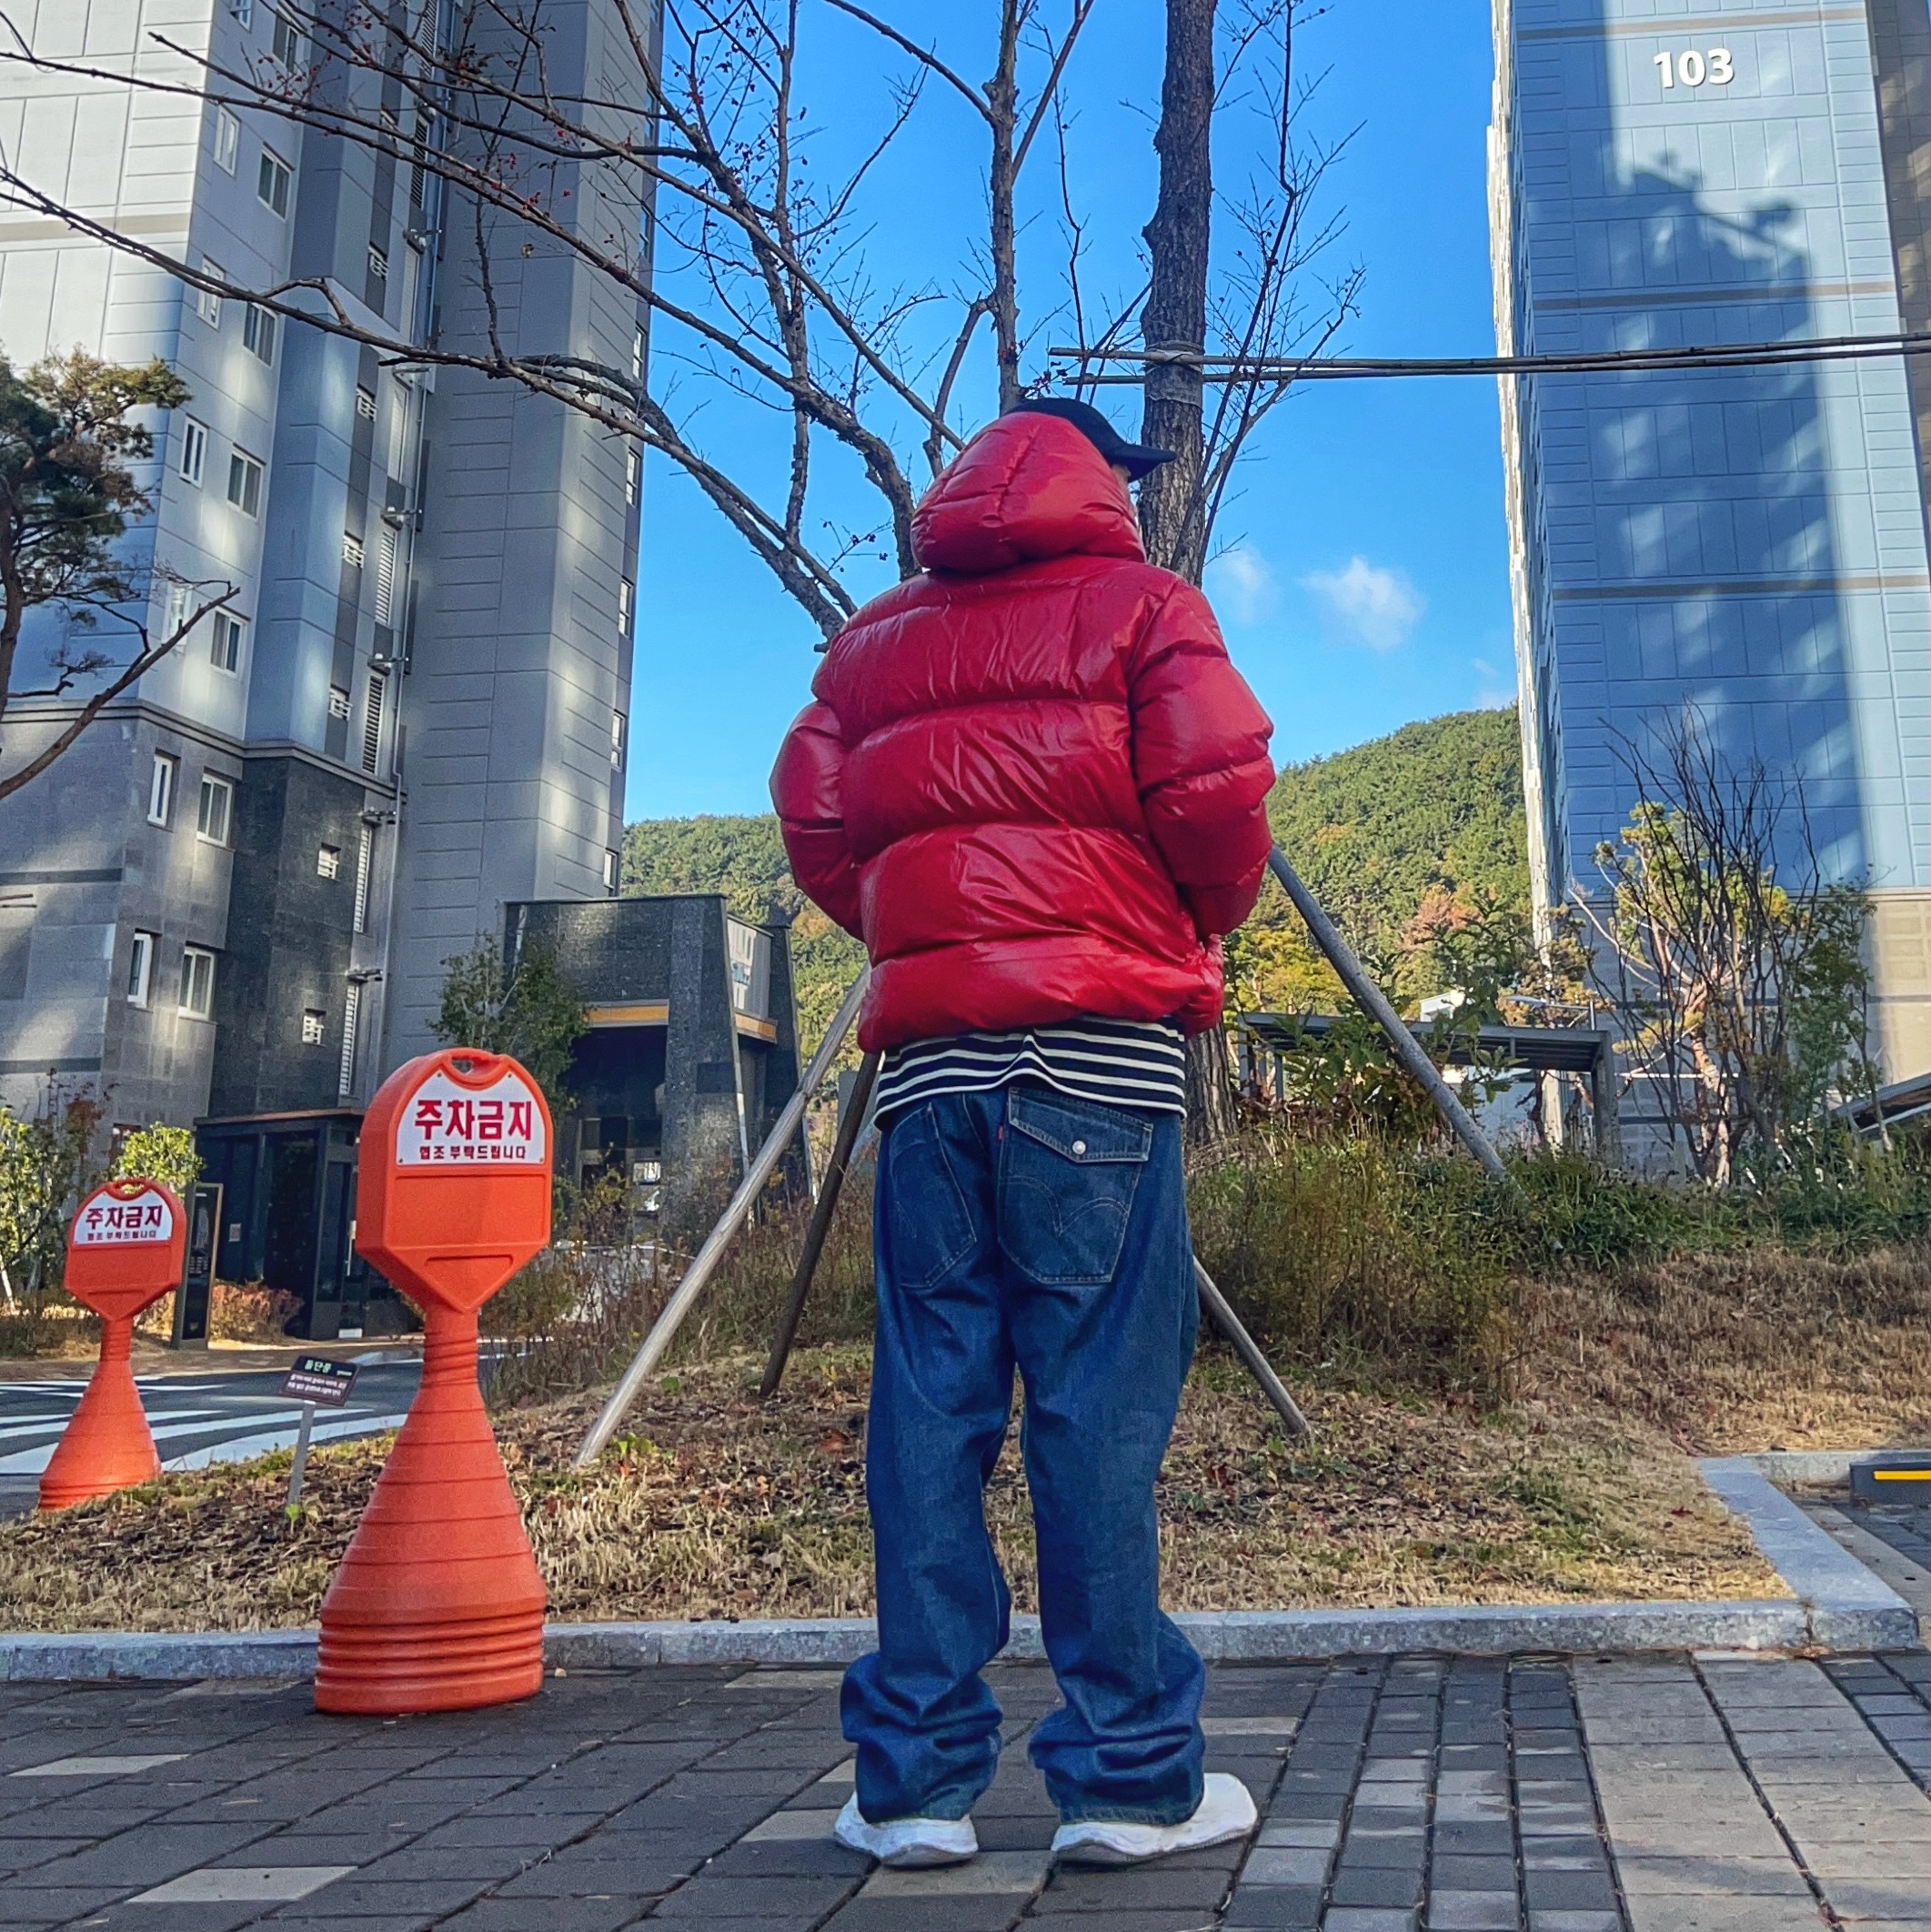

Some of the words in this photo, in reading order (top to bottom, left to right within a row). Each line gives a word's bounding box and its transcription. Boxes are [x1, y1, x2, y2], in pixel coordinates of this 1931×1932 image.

[1654, 47, 1735, 88] 103
[415, 1100, 532, 1141] 주차금지
[419, 1145, 445, 1160] 협조
[450, 1145, 526, 1160] 부탁드립니다
[85, 1205, 163, 1230] 주차금지
